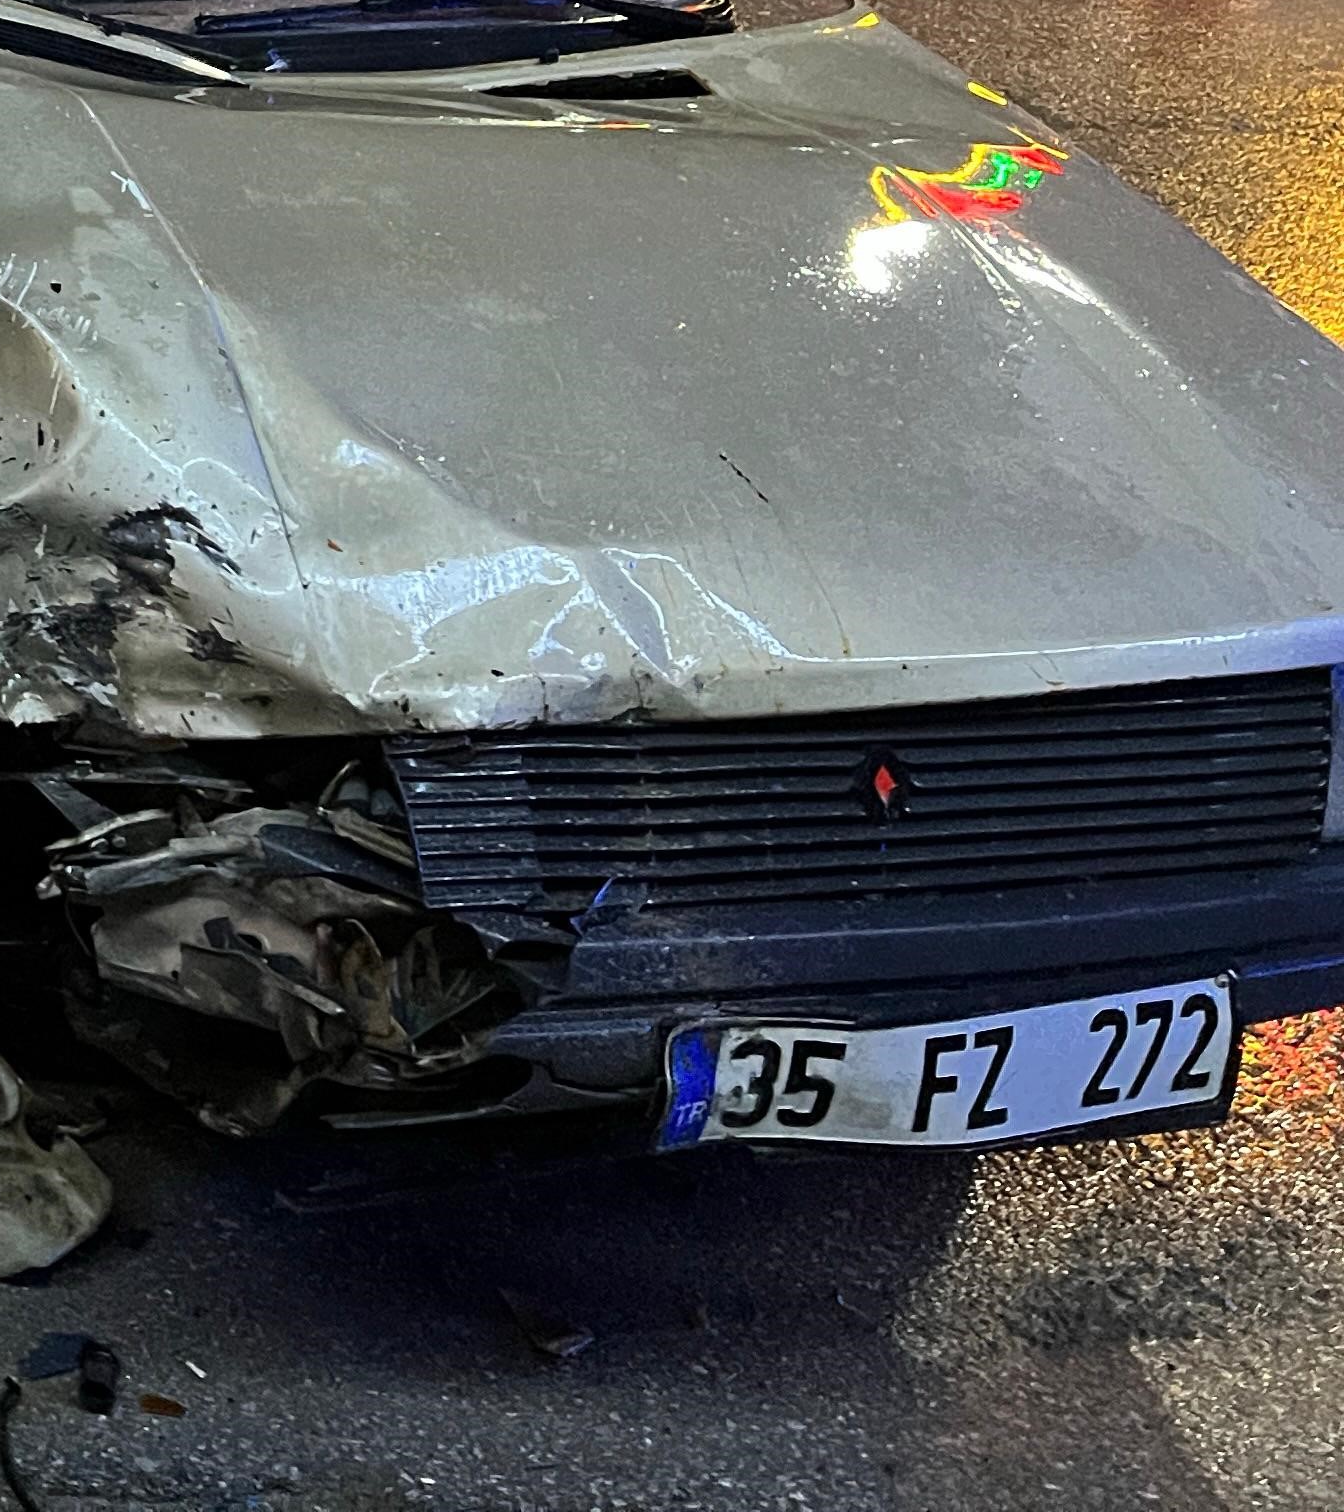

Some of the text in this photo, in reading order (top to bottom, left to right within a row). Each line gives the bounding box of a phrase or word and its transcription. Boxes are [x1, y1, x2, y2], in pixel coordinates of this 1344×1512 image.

[722, 1039, 848, 1128] 35
[912, 1025, 1015, 1133] FZ
[1079, 992, 1219, 1109] 272
